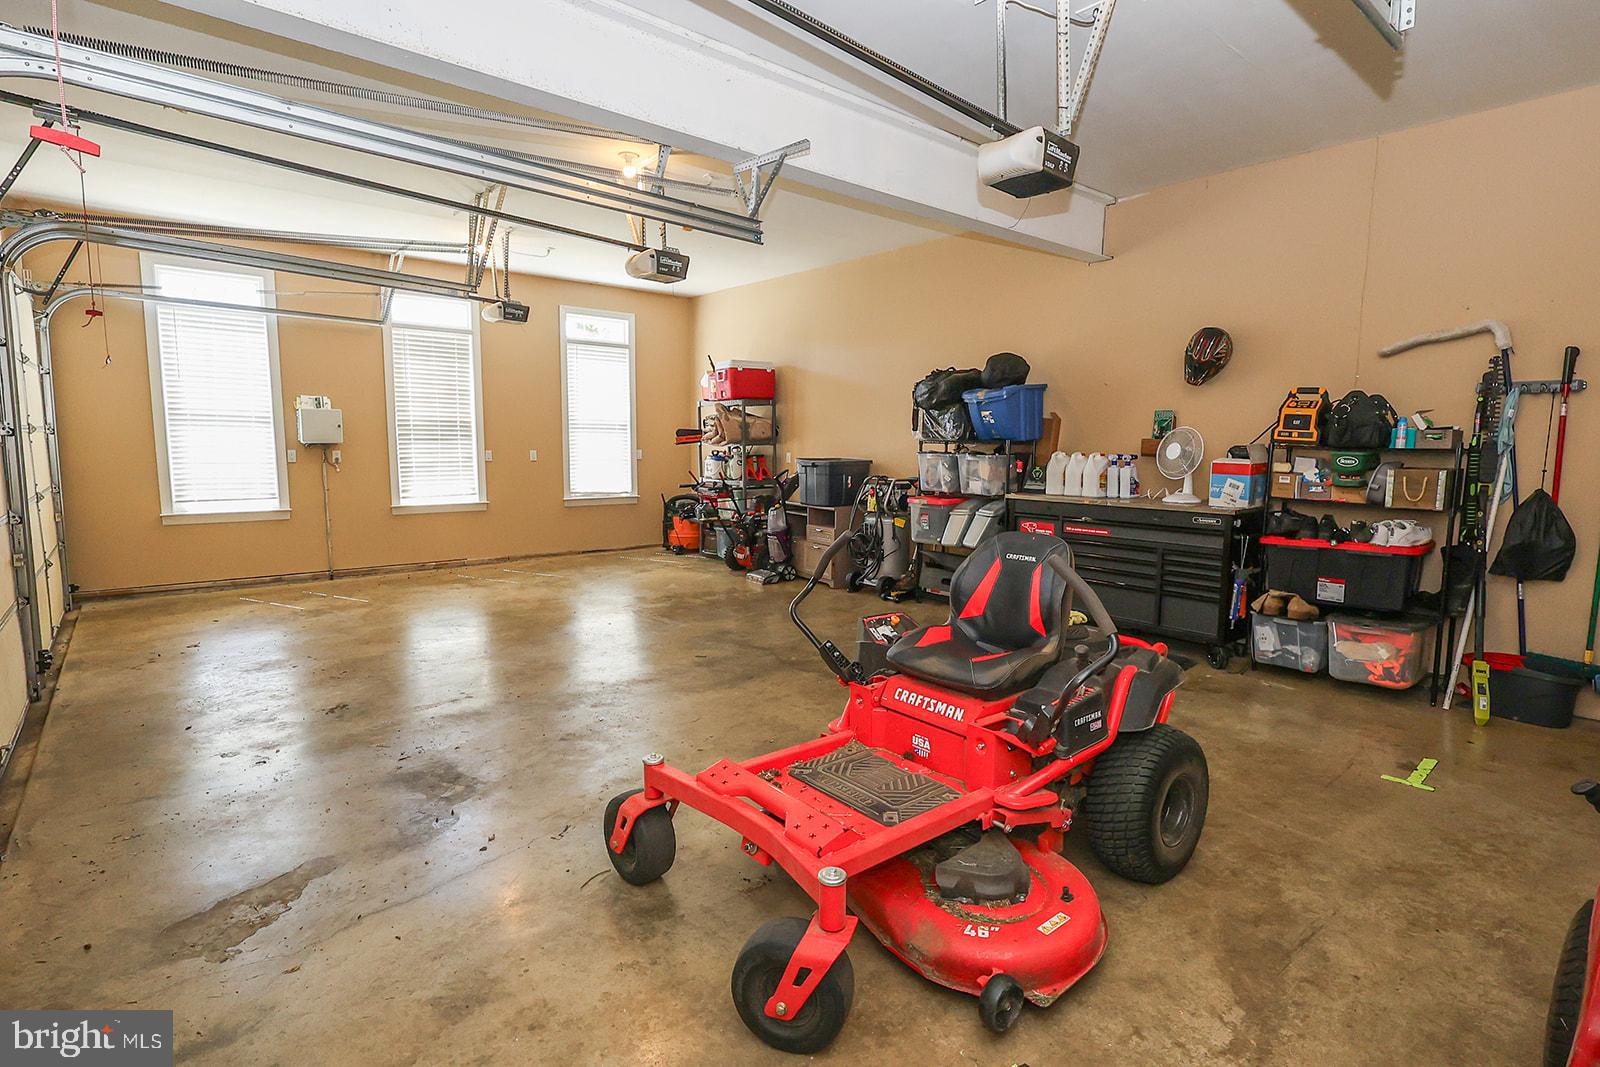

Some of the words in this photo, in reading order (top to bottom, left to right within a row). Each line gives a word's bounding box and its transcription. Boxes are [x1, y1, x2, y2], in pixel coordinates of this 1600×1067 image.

[1006, 553, 1036, 562] CRAFTSMAN
[894, 688, 965, 722] CRAFTSMAN
[1075, 711, 1102, 727] CRAFTSMAN
[912, 735, 931, 750] USA
